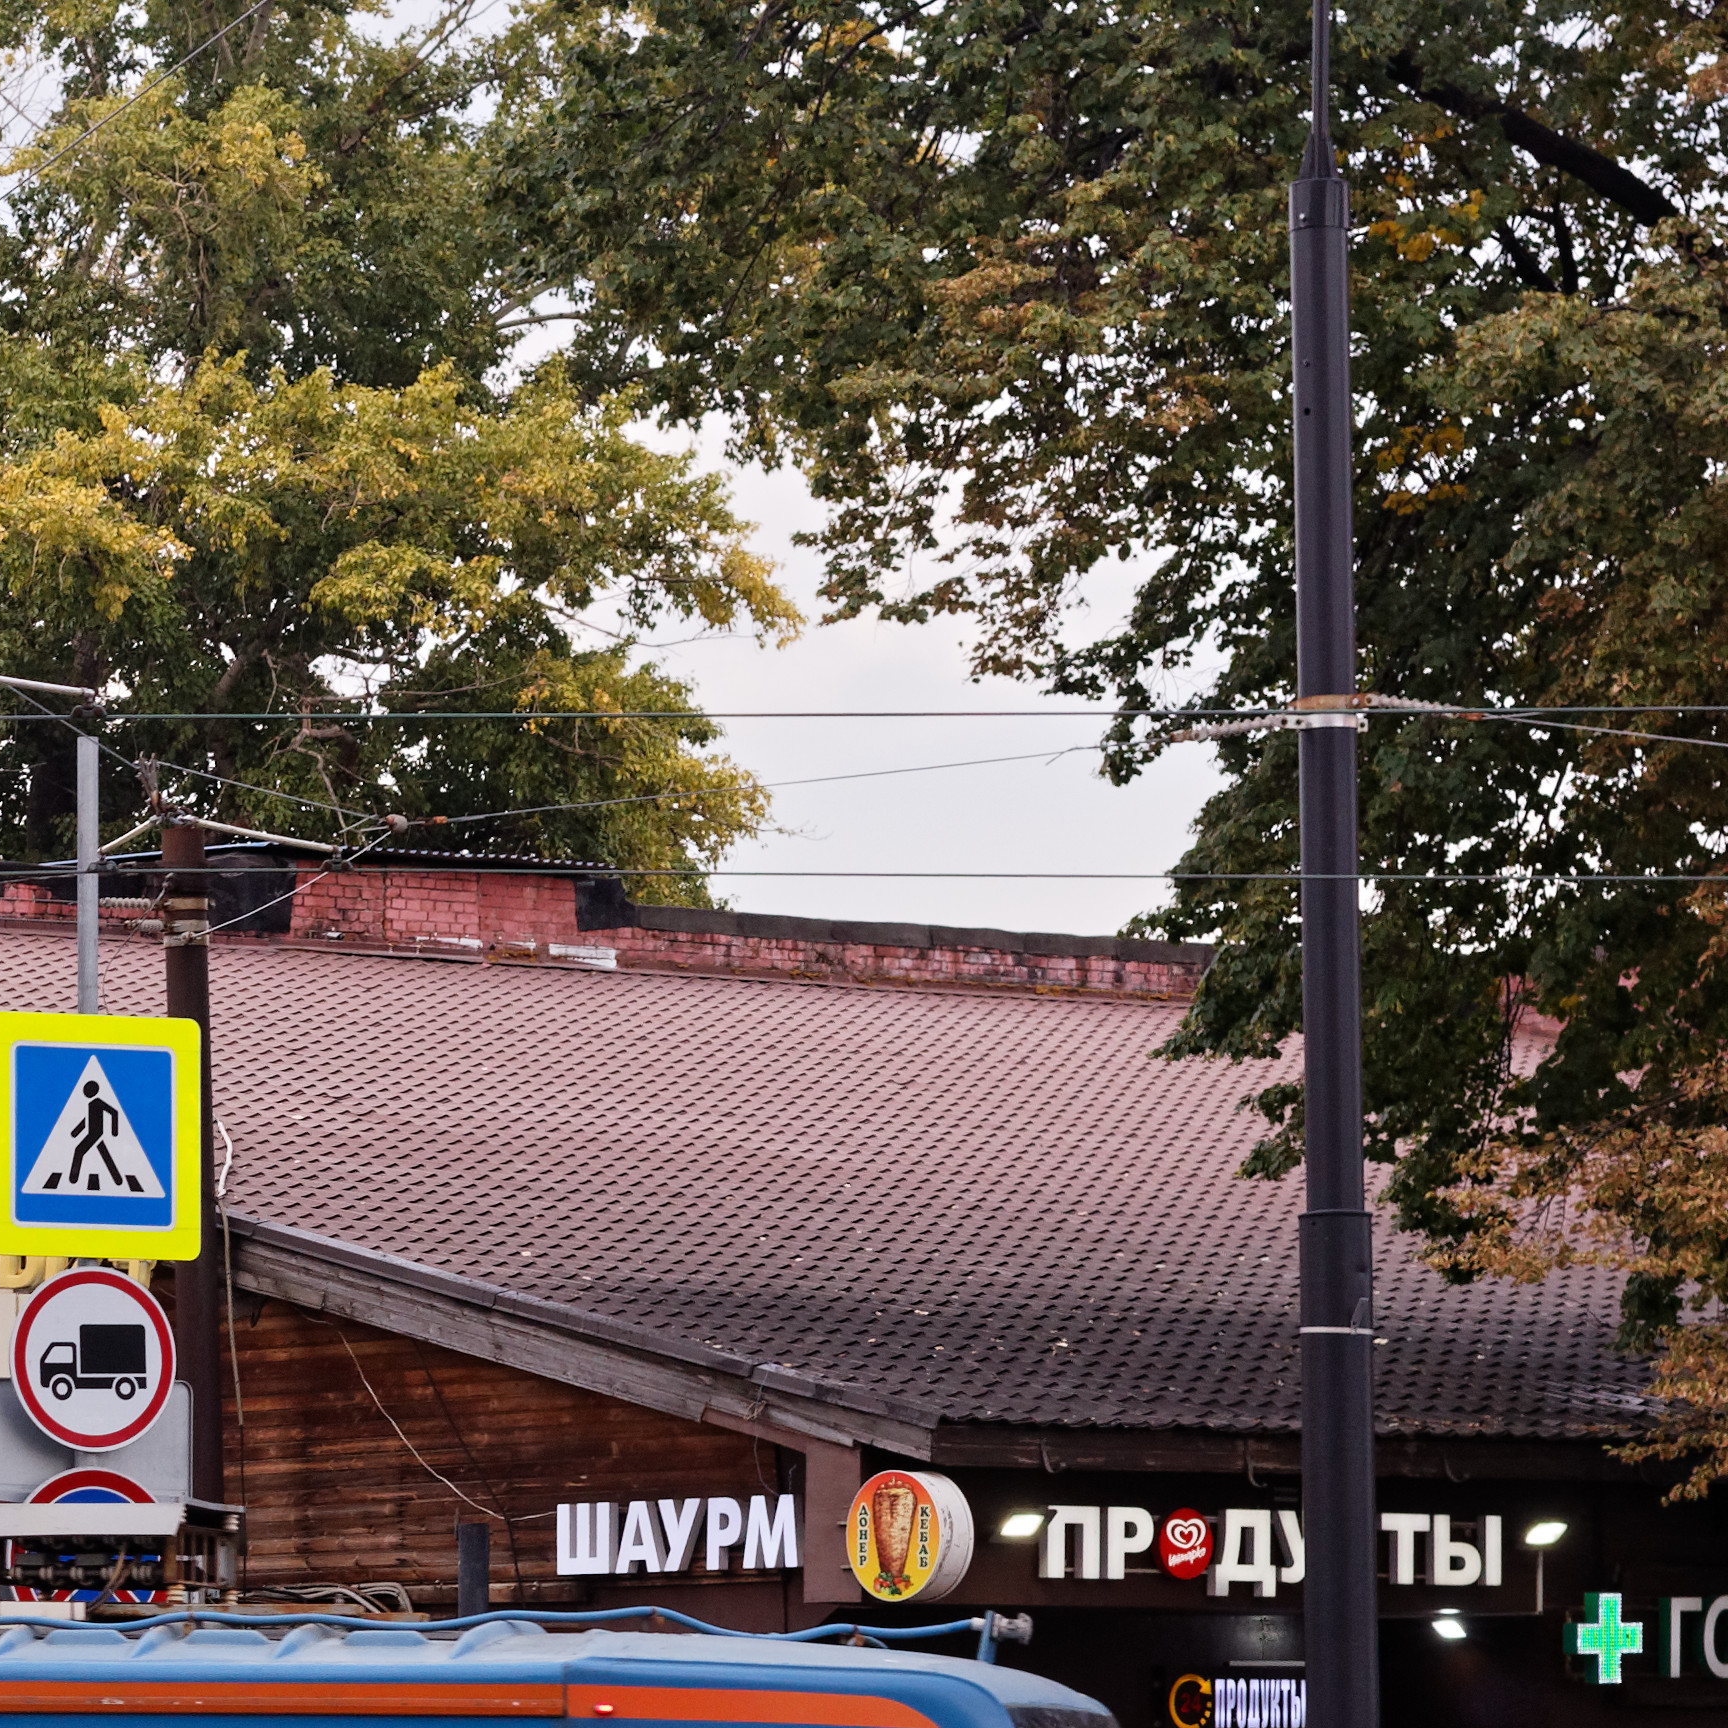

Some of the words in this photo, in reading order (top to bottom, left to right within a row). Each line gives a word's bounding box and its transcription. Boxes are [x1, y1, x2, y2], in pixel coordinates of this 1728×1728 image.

[858, 1502, 870, 1568] ДОНЕР
[918, 1504, 931, 1570] КЕБАБ
[1041, 1505, 1502, 1598] ПРОДУТЫ
